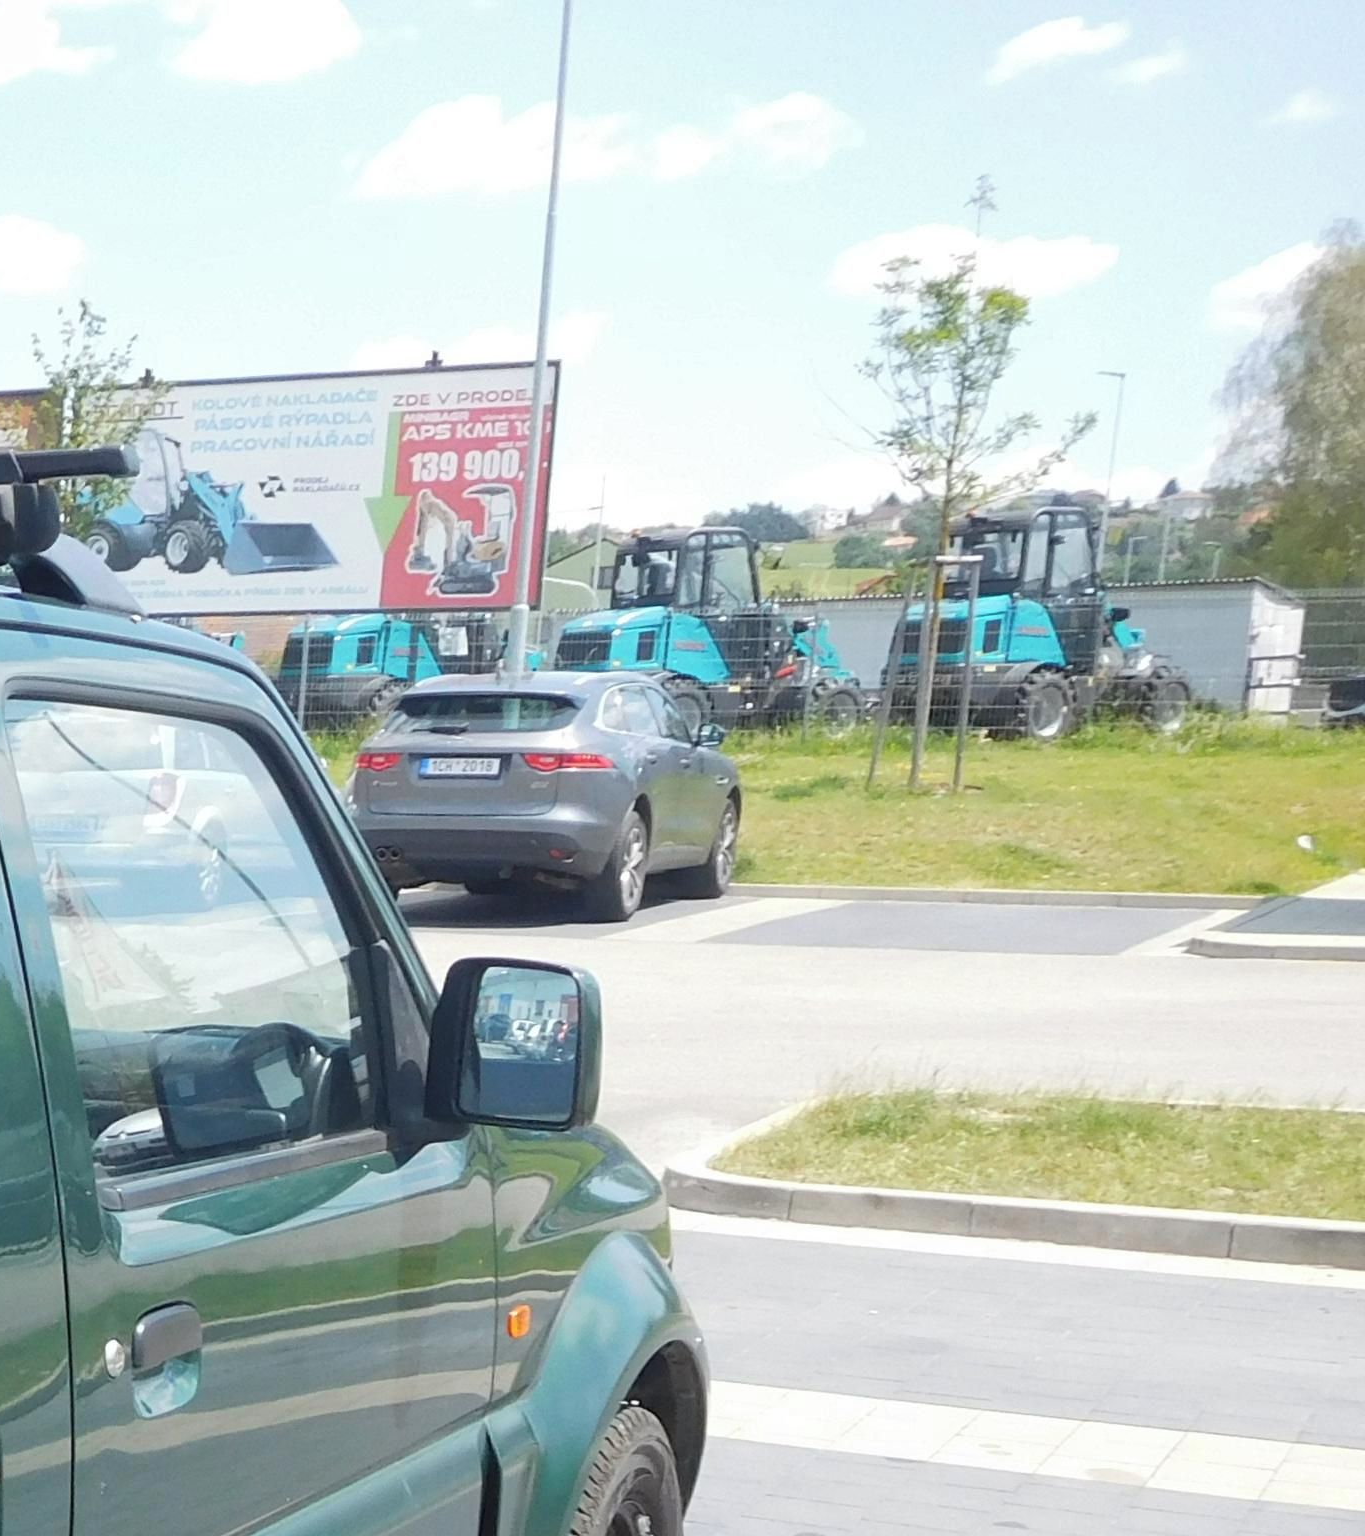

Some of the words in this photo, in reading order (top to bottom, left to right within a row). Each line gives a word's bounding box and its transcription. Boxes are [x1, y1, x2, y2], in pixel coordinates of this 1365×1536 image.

[192, 393, 261, 411] KOLOVÉ
[267, 390, 379, 407] NAKLADAČE
[392, 394, 430, 407] ZDE
[437, 392, 452, 404] V
[457, 389, 533, 403] PRODE
[194, 412, 271, 431] PÁSOVÉ
[278, 410, 373, 428] RÝPADLA
[190, 434, 292, 453] PRACOVNÍ
[296, 431, 375, 449] NÁŘADÍ
[402, 424, 451, 441] APS
[455, 422, 509, 438] KME
[409, 451, 458, 482] 139
[462, 759, 494, 772] 2018
